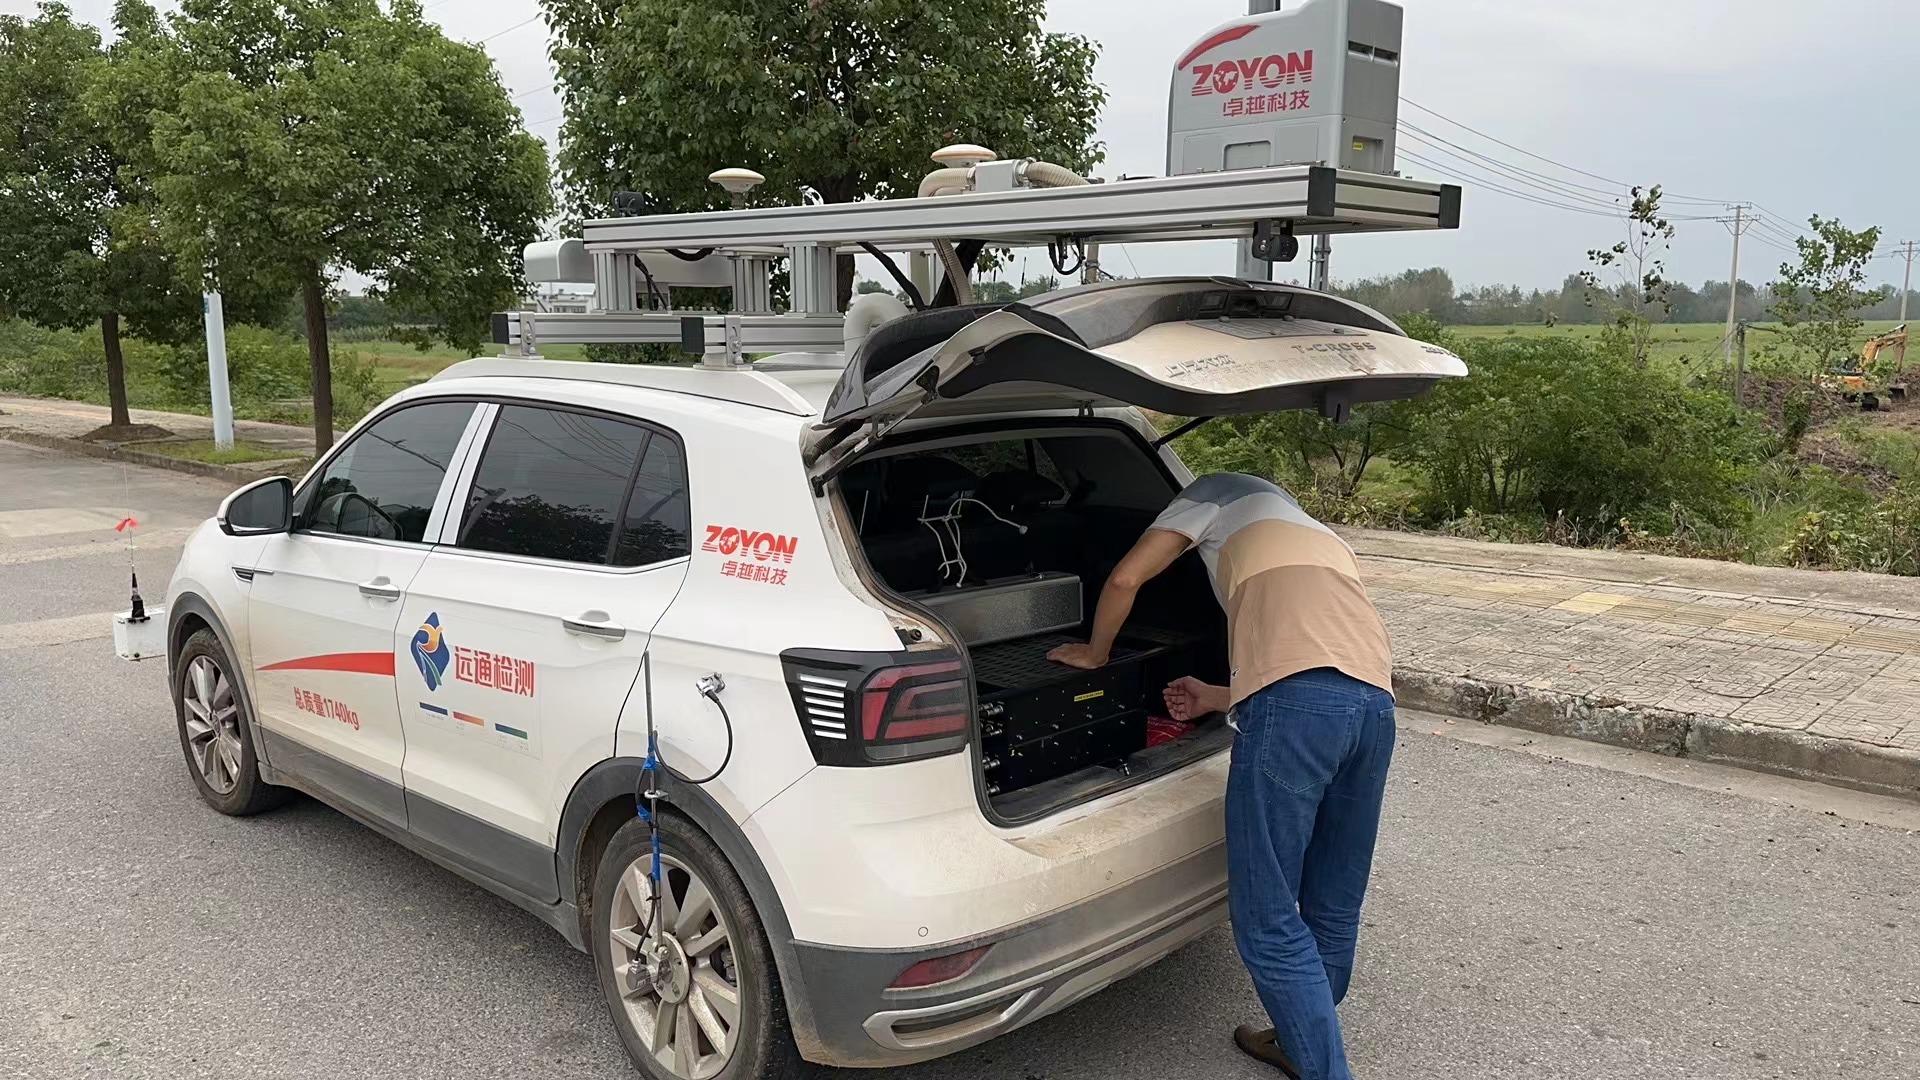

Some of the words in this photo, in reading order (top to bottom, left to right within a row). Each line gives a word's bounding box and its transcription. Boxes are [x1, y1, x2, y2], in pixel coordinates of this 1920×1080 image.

[1191, 49, 1314, 97] ZOYON
[1222, 89, 1310, 117] 卓越科技
[1290, 341, 1377, 354] T-CROSS
[701, 524, 799, 564] ZOYON
[720, 559, 789, 586] 卓越科技
[454, 646, 536, 698] 远通检测
[293, 686, 361, 731] 总质量1740kg
